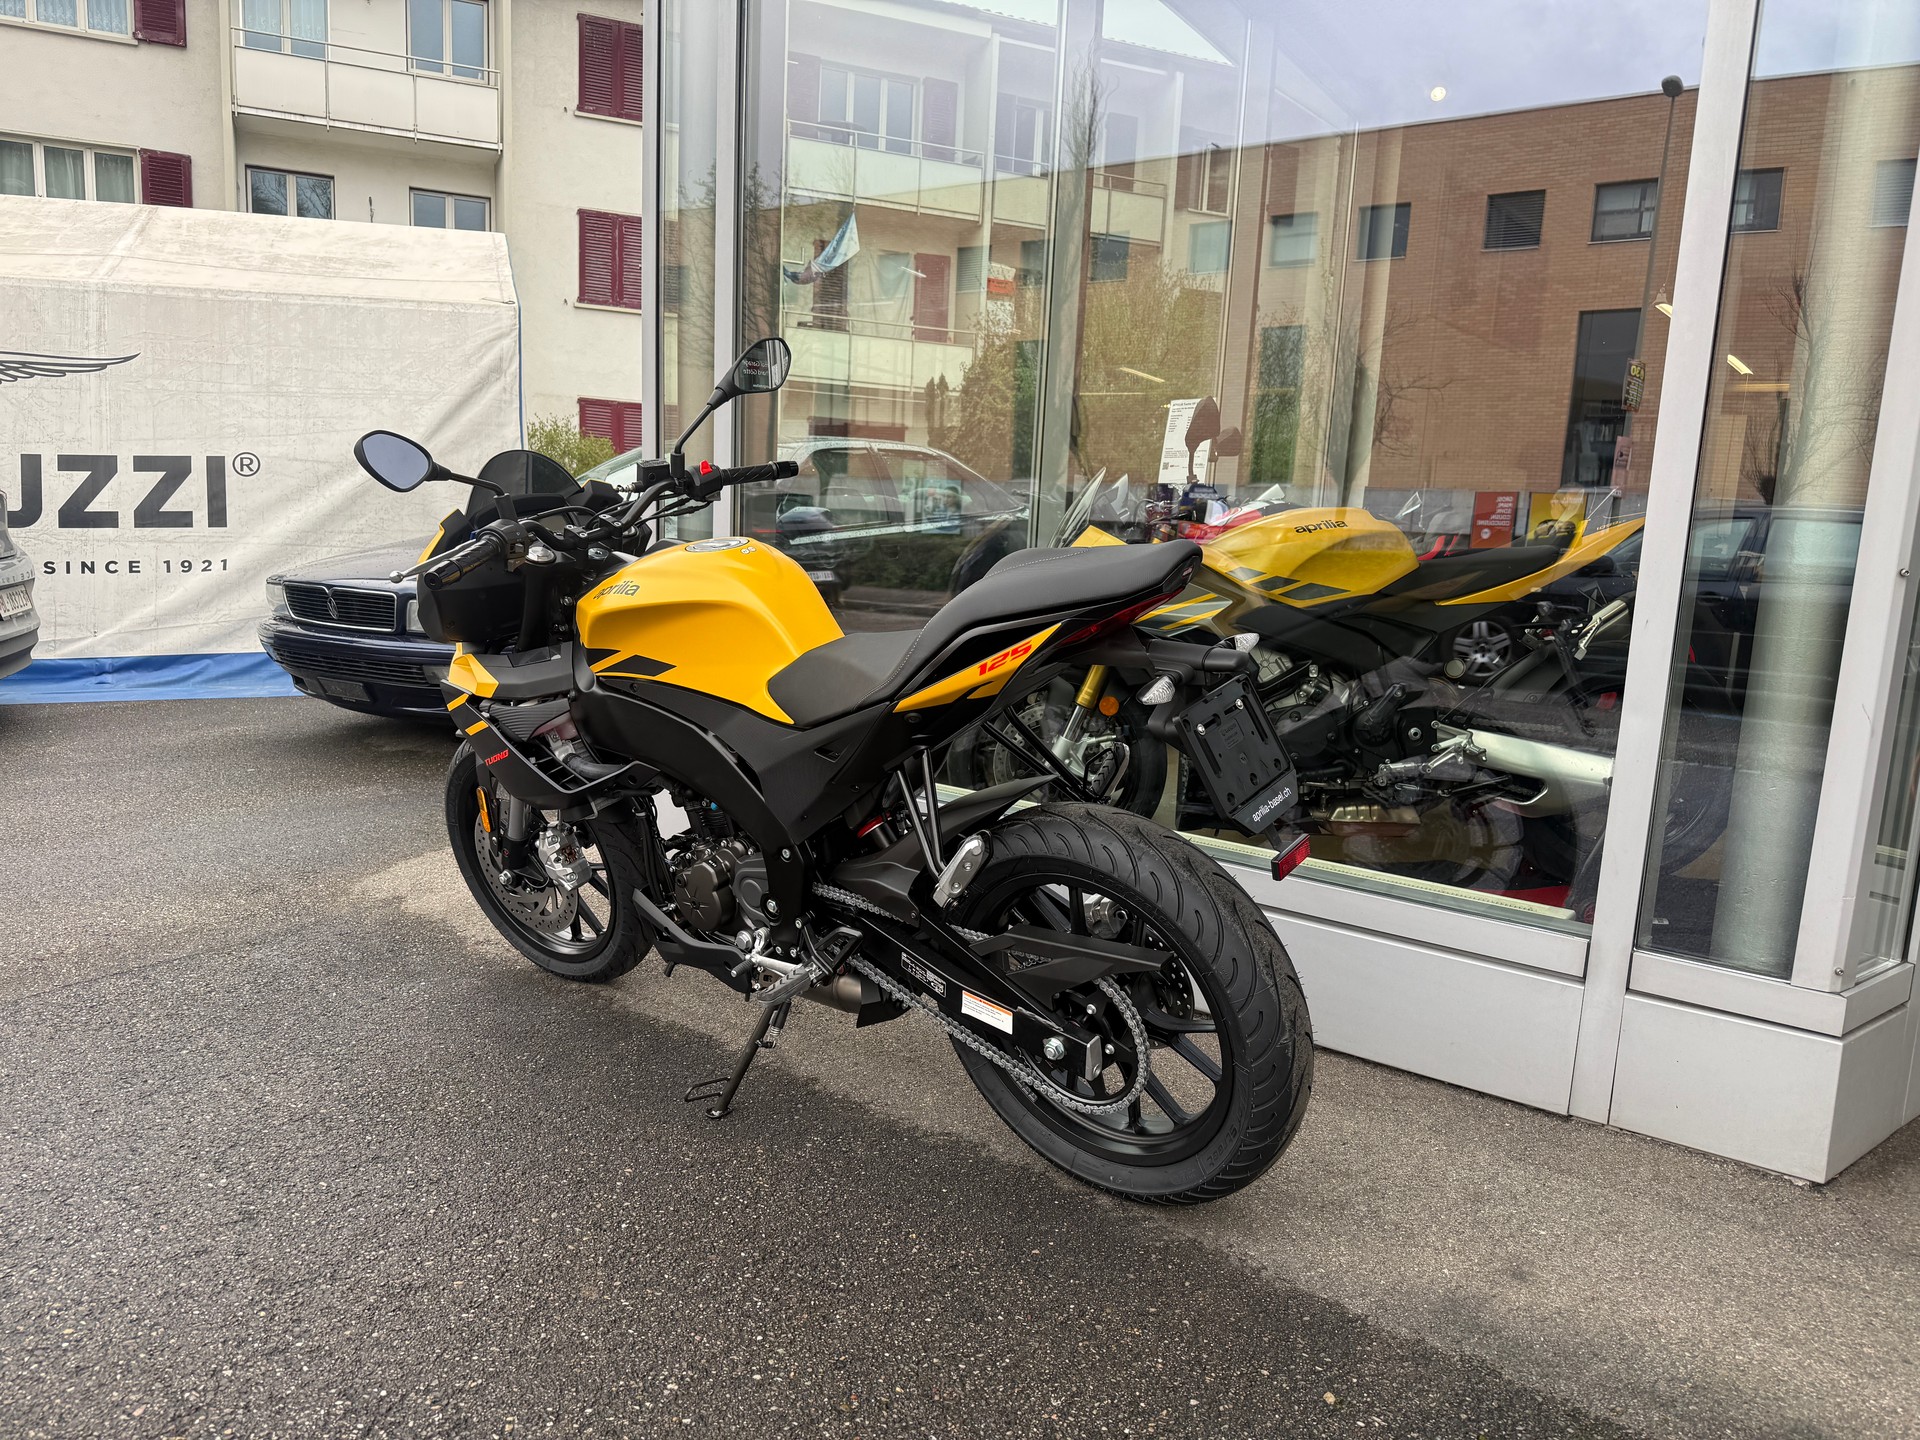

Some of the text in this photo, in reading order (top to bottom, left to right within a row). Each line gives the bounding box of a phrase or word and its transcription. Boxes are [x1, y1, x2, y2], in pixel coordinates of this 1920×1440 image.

[1294, 519, 1349, 534] aprilia
[43, 558, 229, 575] SINCE 1921
[592, 580, 641, 600] aprilia
[978, 639, 1033, 677] 125
[484, 748, 510, 767] TUONO
[1252, 786, 1292, 822] aprilia-basel.ch
